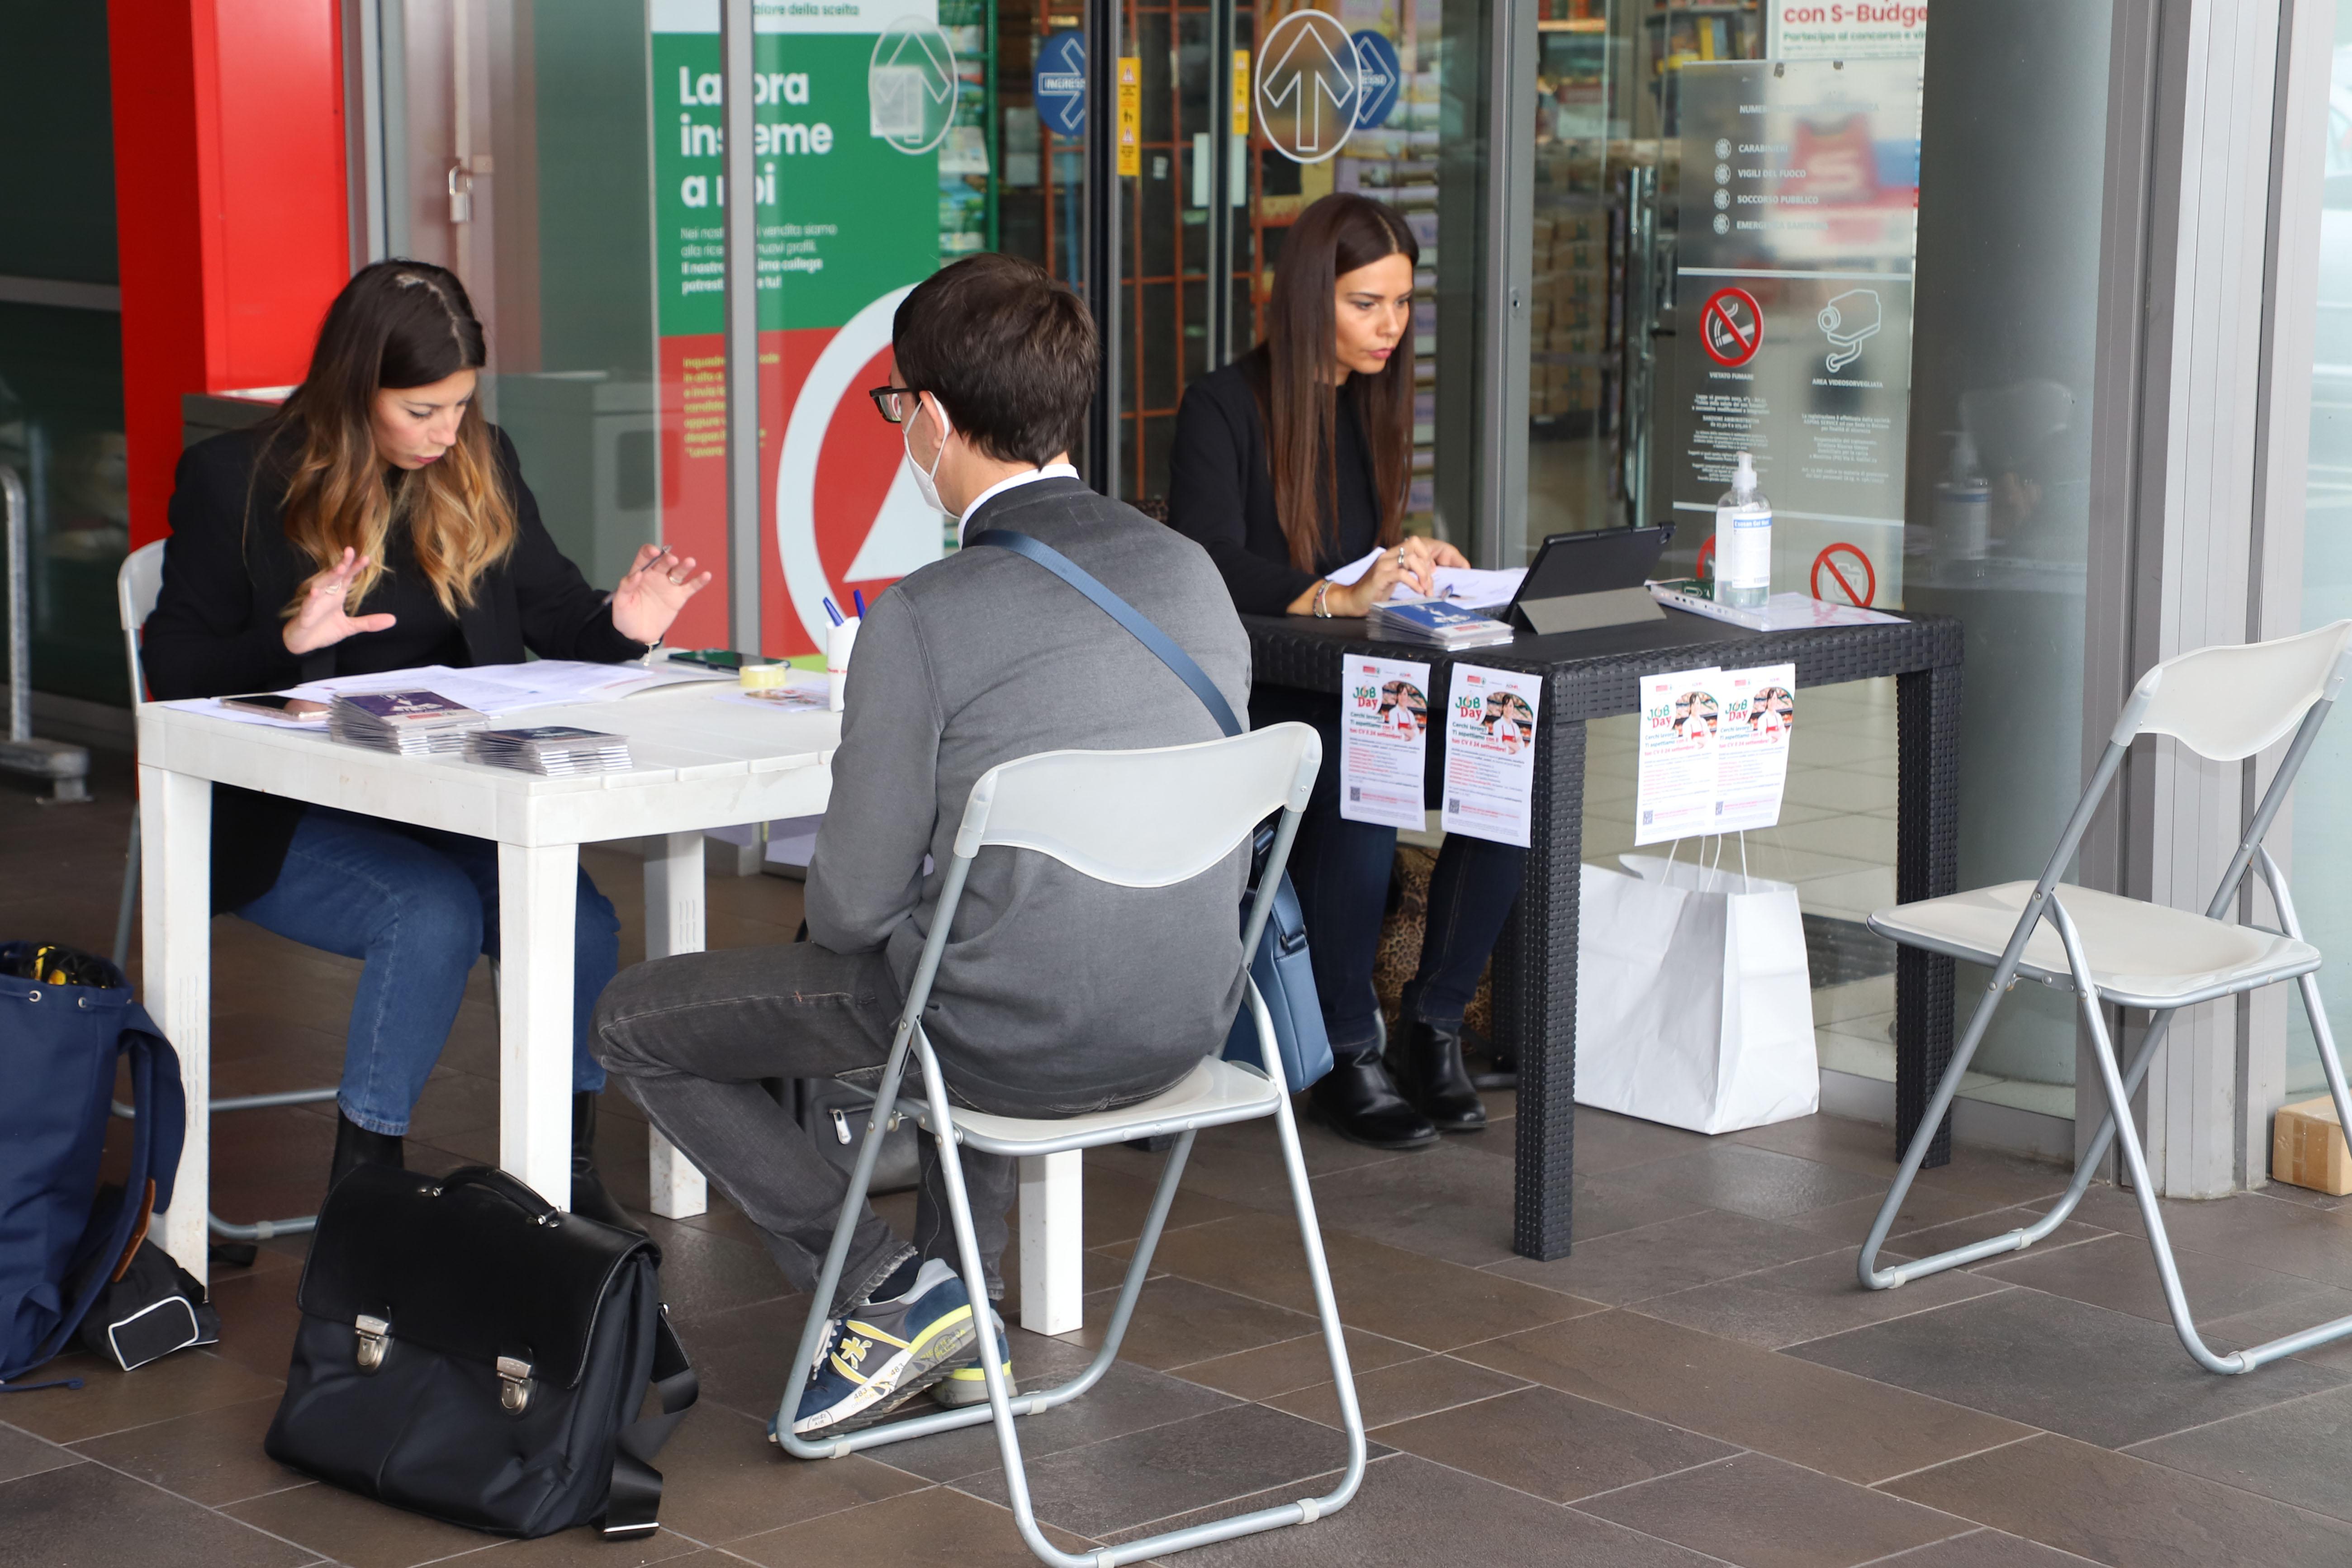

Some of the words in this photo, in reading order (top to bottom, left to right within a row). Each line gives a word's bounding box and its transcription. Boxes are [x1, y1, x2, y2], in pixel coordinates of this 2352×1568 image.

[788, 3, 819, 15] della
[822, 4, 858, 15] scelta
[1784, 8, 1825, 23] con
[679, 66, 809, 105] Laora
[679, 113, 834, 156] ineme
[1738, 144, 1788, 153] CARABINIERI
[1738, 169, 1761, 178] VIGILI
[1764, 170, 1777, 178] DEL
[1780, 169, 1806, 178] FUOCO
[680, 175, 707, 208] a
[1737, 195, 1778, 204] SOCCORSO
[1780, 195, 1819, 204] PUBBLICO
[681, 227, 698, 240] Nei
[762, 223, 802, 237] vendita
[803, 223, 838, 236] siamo
[681, 244, 701, 258] alla
[781, 257, 823, 274] collega
[1828, 379, 1883, 388] VIDEOSORVEGLIATA
[1353, 686, 1376, 698] JOB
[1358, 696, 1378, 711] Day
[1455, 696, 1480, 709] JOB
[1725, 699, 1747, 714] JOB
[1461, 706, 1482, 721] Day
[1647, 705, 1670, 721] JOB
[1729, 710, 1748, 722] Day
[1652, 716, 1672, 729] Day
[891, 1363, 904, 1375] 483
[854, 1387, 867, 1399] 483
